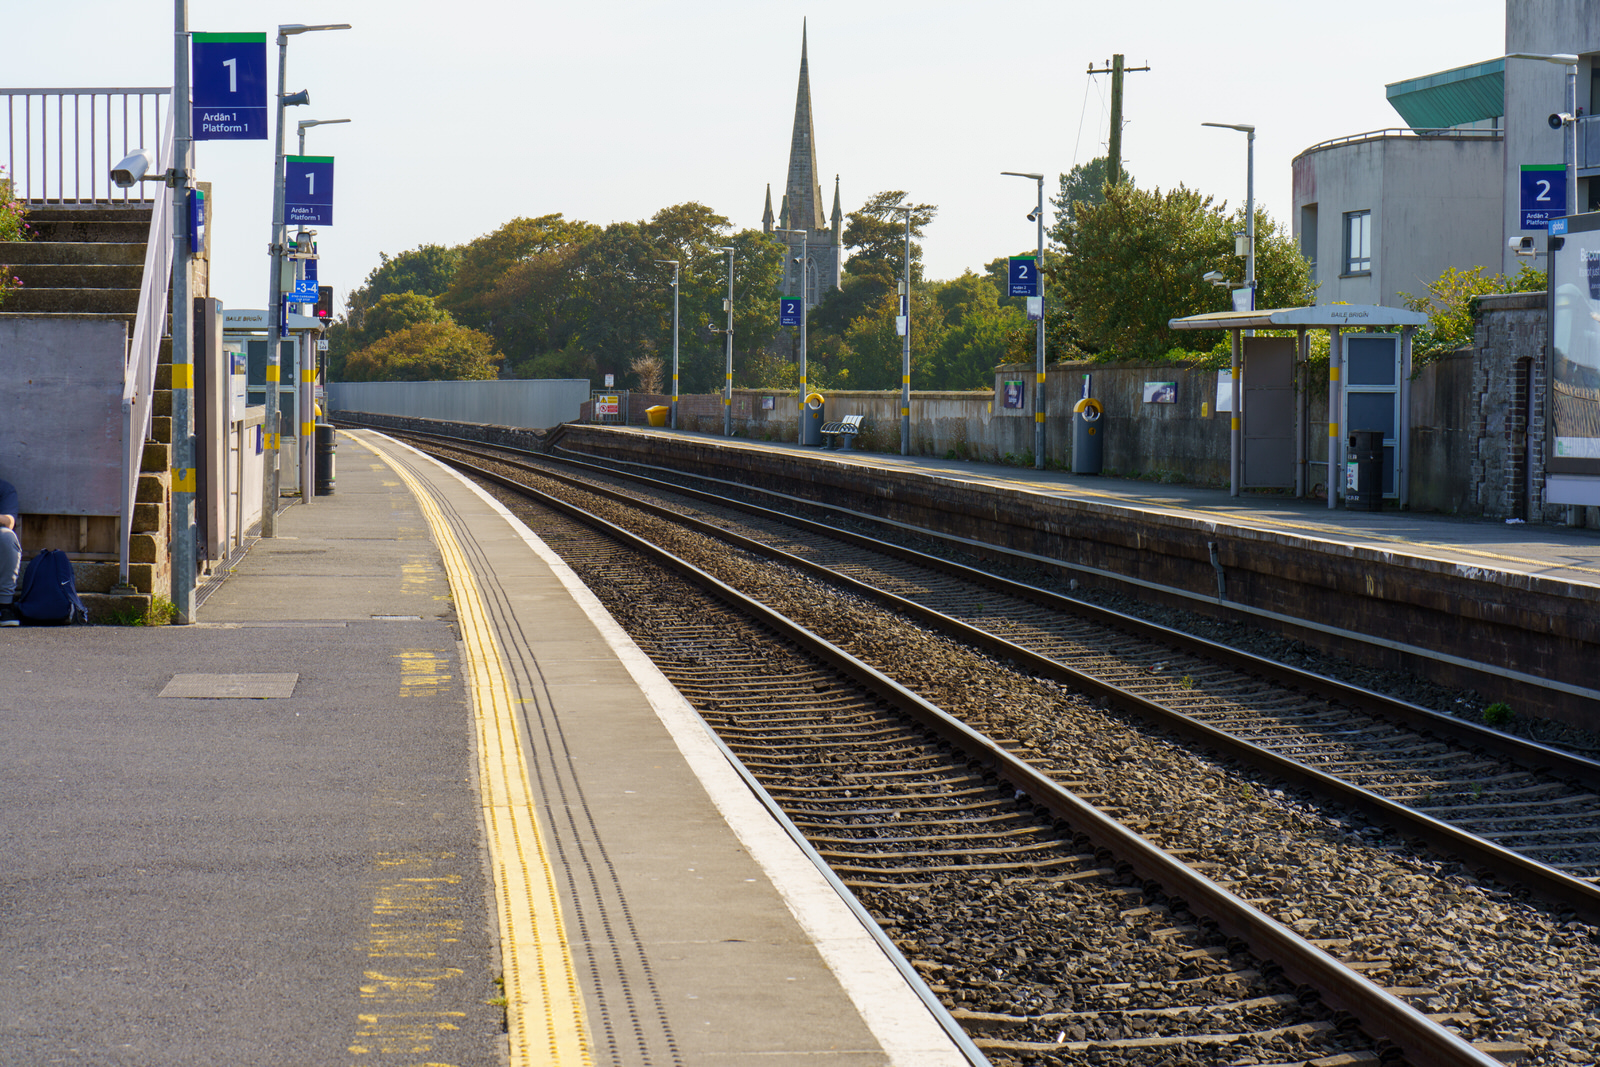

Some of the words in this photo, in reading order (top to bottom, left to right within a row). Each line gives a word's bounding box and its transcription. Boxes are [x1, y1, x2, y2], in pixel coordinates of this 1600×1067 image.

[222, 58, 237, 93] 1
[202, 112, 231, 122] Ardán
[232, 112, 237, 122] 1
[202, 123, 242, 132] Platform
[244, 123, 249, 132] 1
[305, 172, 315, 195] 1
[1536, 179, 1551, 201] 2
[1552, 219, 1565, 234] global
[1018, 265, 1028, 279] 2
[787, 303, 795, 314] 2
